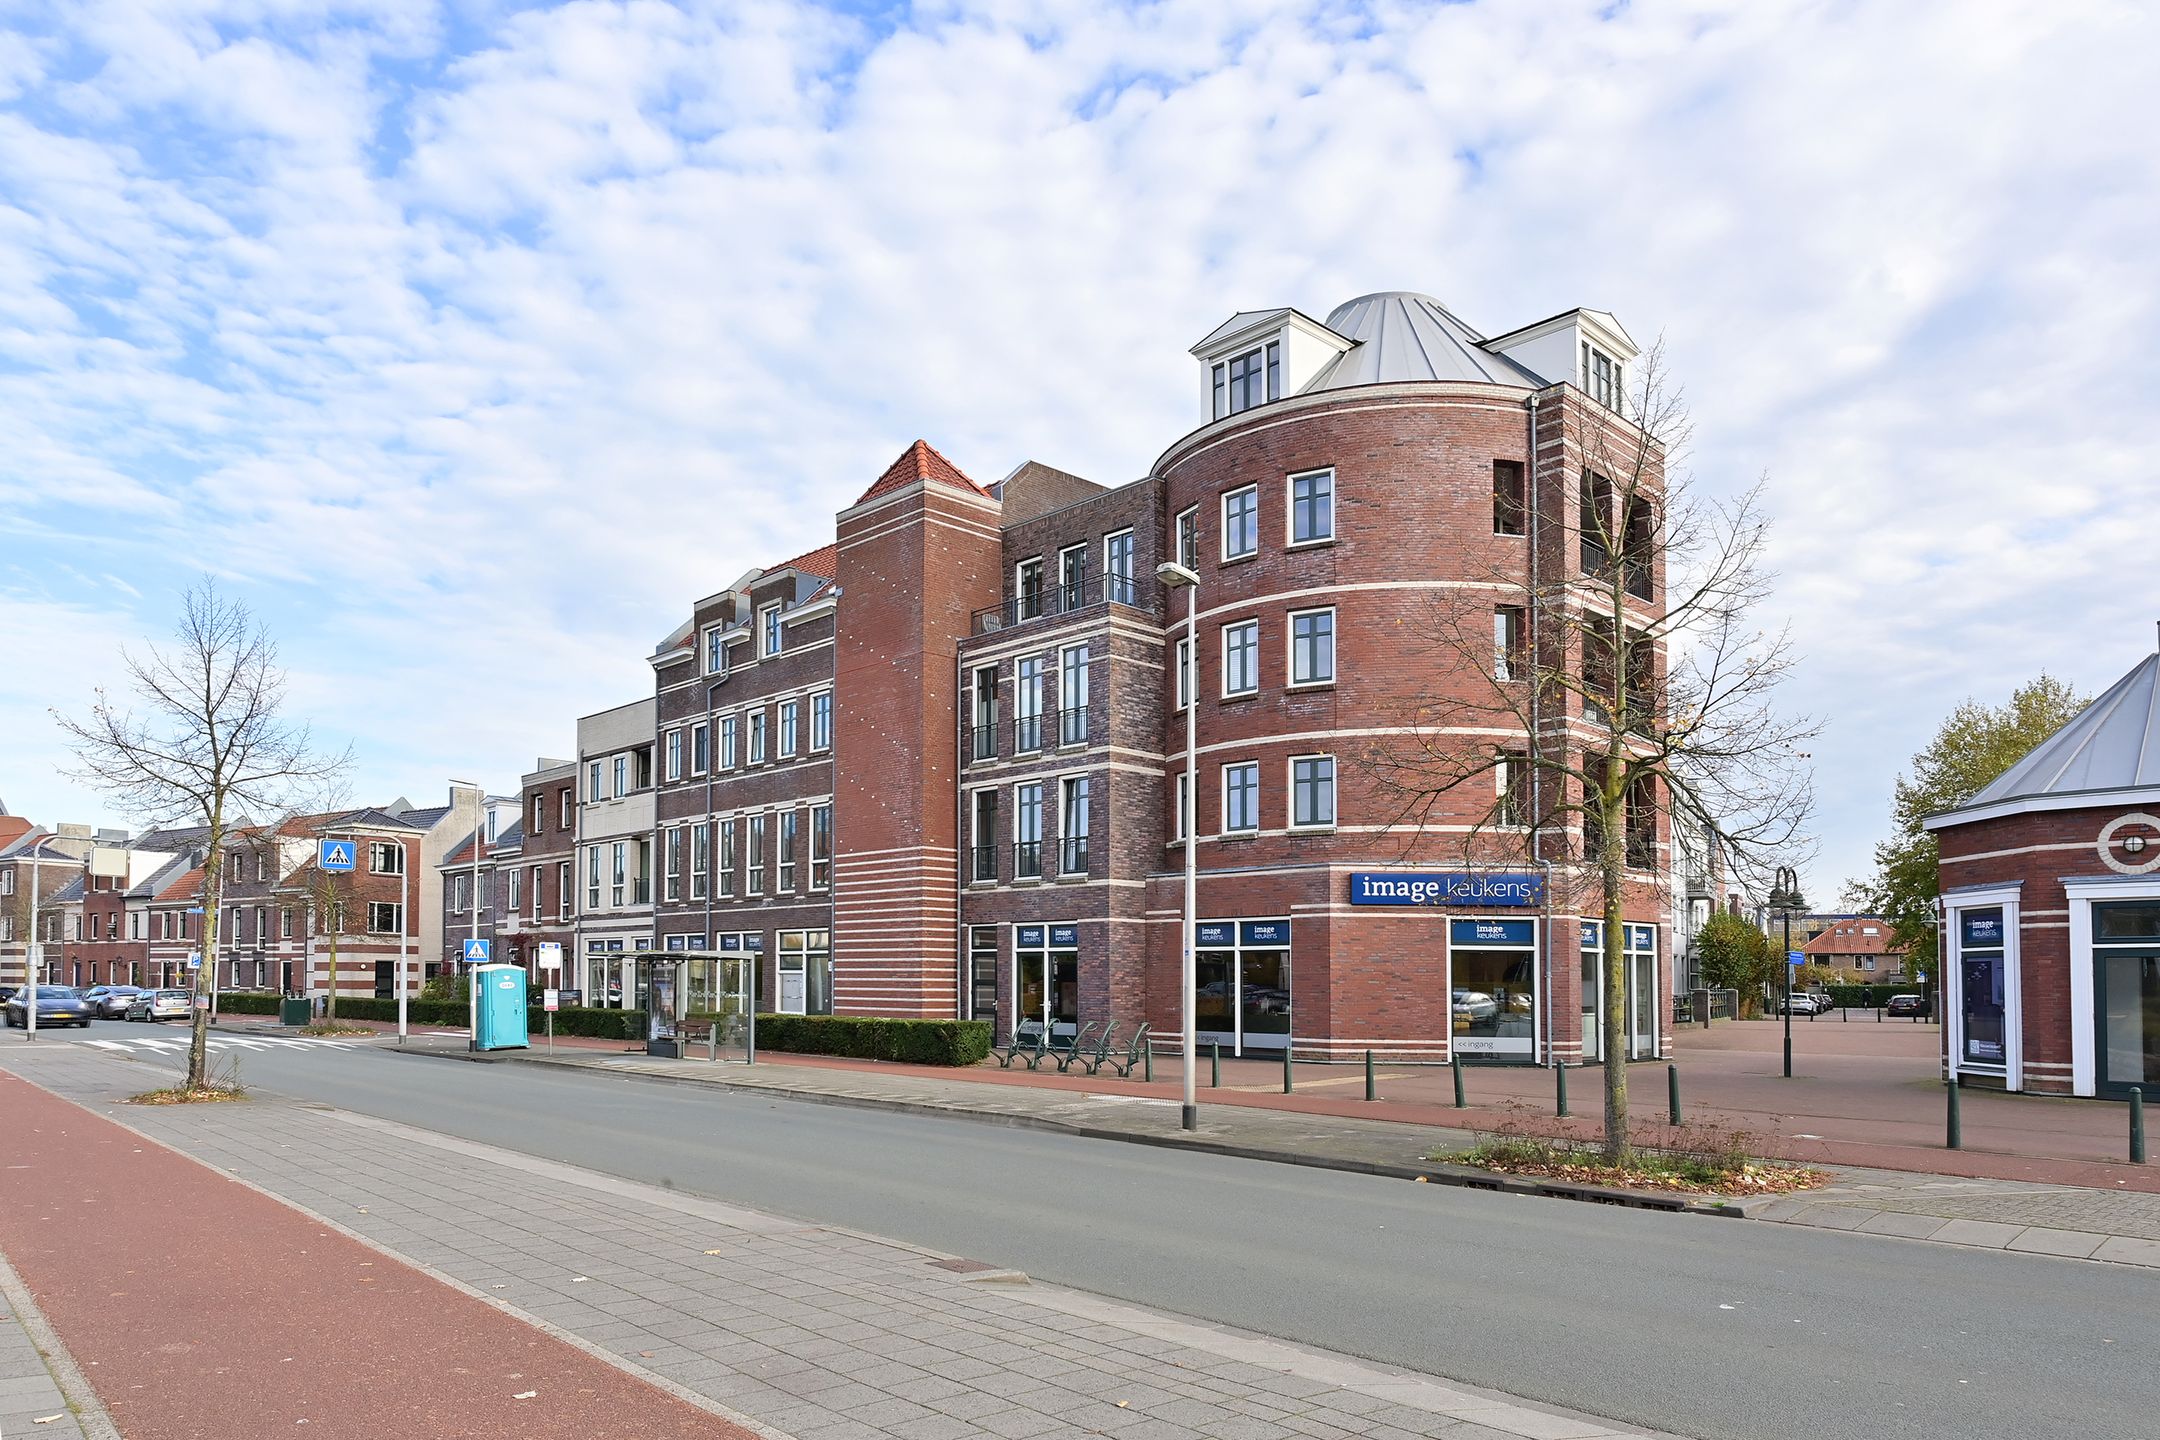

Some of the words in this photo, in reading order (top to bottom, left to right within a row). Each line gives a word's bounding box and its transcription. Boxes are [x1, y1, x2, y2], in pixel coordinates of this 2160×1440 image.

[1362, 876, 1440, 902] image
[1447, 878, 1531, 898] keukens
[1972, 919, 1994, 930] image
[1023, 929, 1039, 937] image
[1055, 929, 1072, 937] image
[1201, 927, 1222, 935] image
[1254, 925, 1275, 934] image
[1476, 924, 1504, 934] image
[1972, 929, 1997, 937] keukens
[1254, 932, 1278, 940] keukens
[1476, 932, 1508, 940] keukens
[1467, 1041, 1494, 1050] ingang
